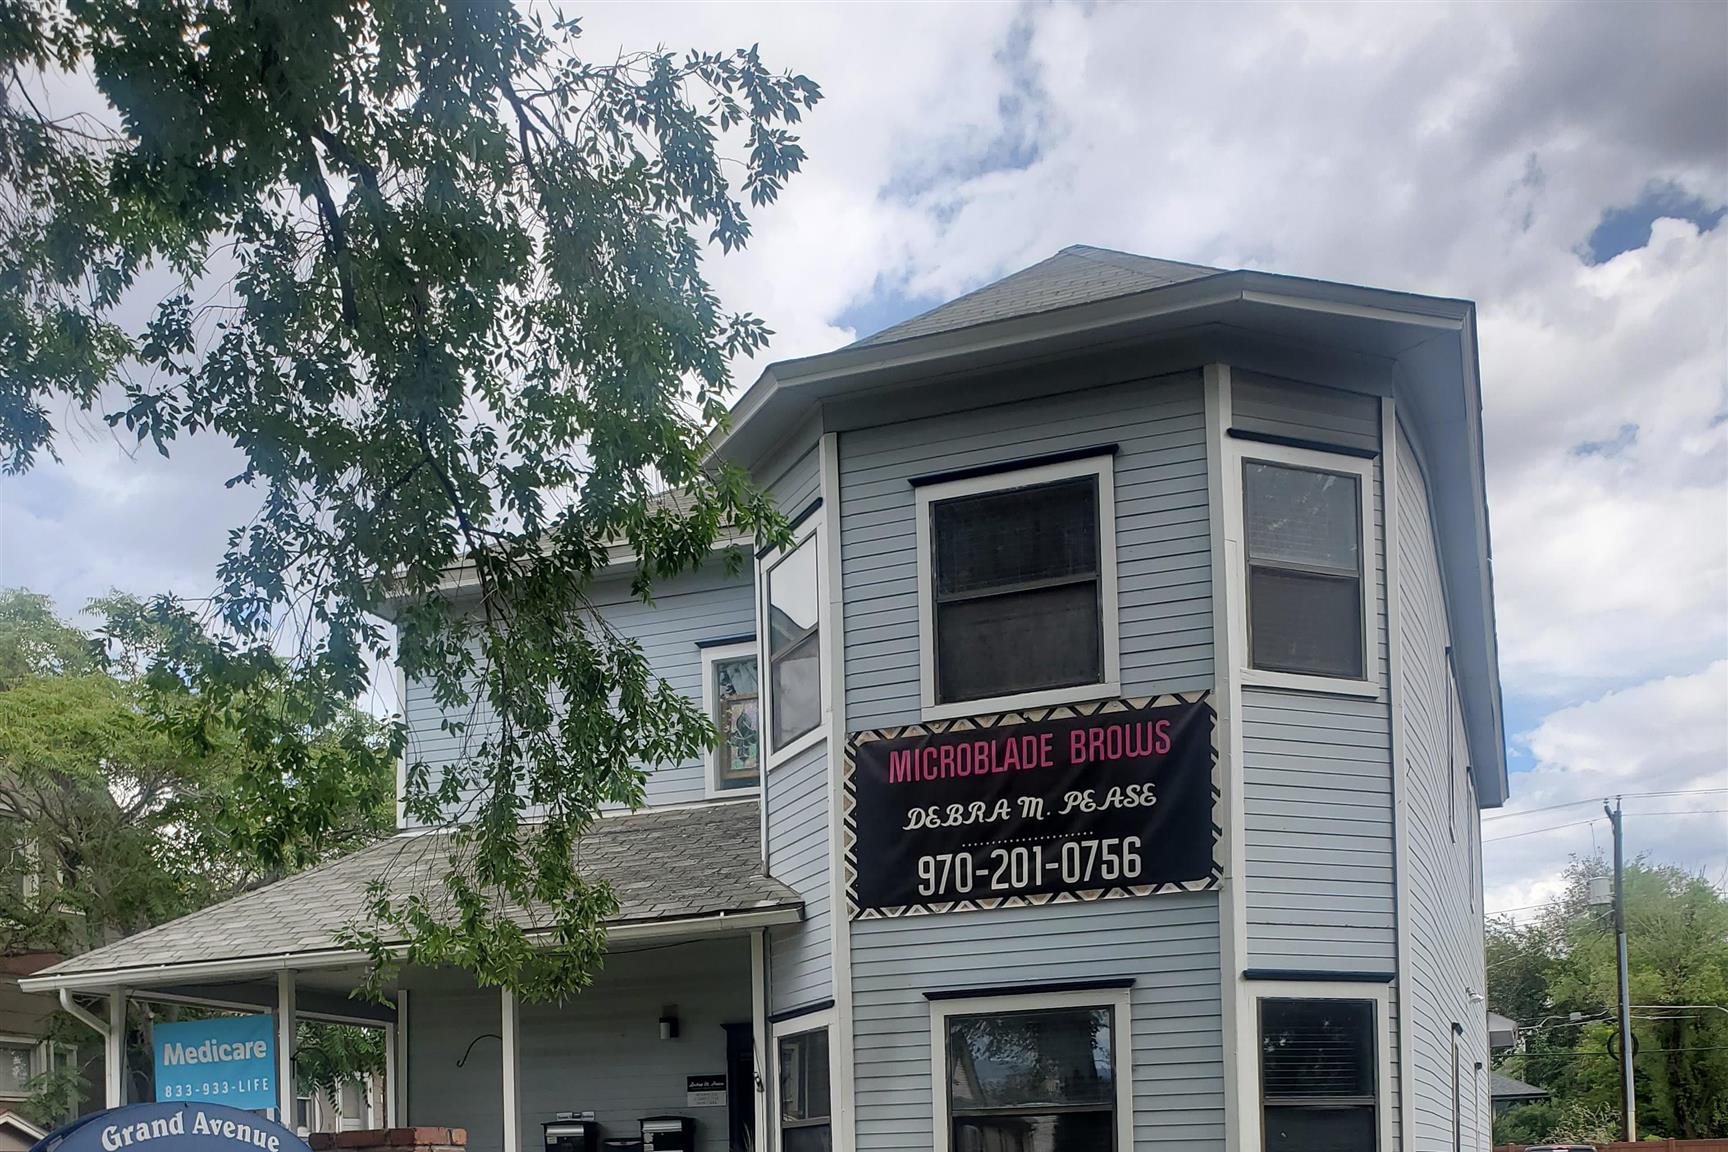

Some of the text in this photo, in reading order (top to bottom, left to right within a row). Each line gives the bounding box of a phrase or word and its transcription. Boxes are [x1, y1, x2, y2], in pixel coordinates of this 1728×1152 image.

[888, 719, 1171, 783] MICROBLADE BROWS
[902, 783, 1157, 830] DEBRA M. PEASE
[917, 836, 1142, 896] 970-201-0756
[163, 1039, 267, 1066] Medicare
[164, 1078, 269, 1098] 833-933-LIFE
[101, 1111, 280, 1152] Grand Avenue
